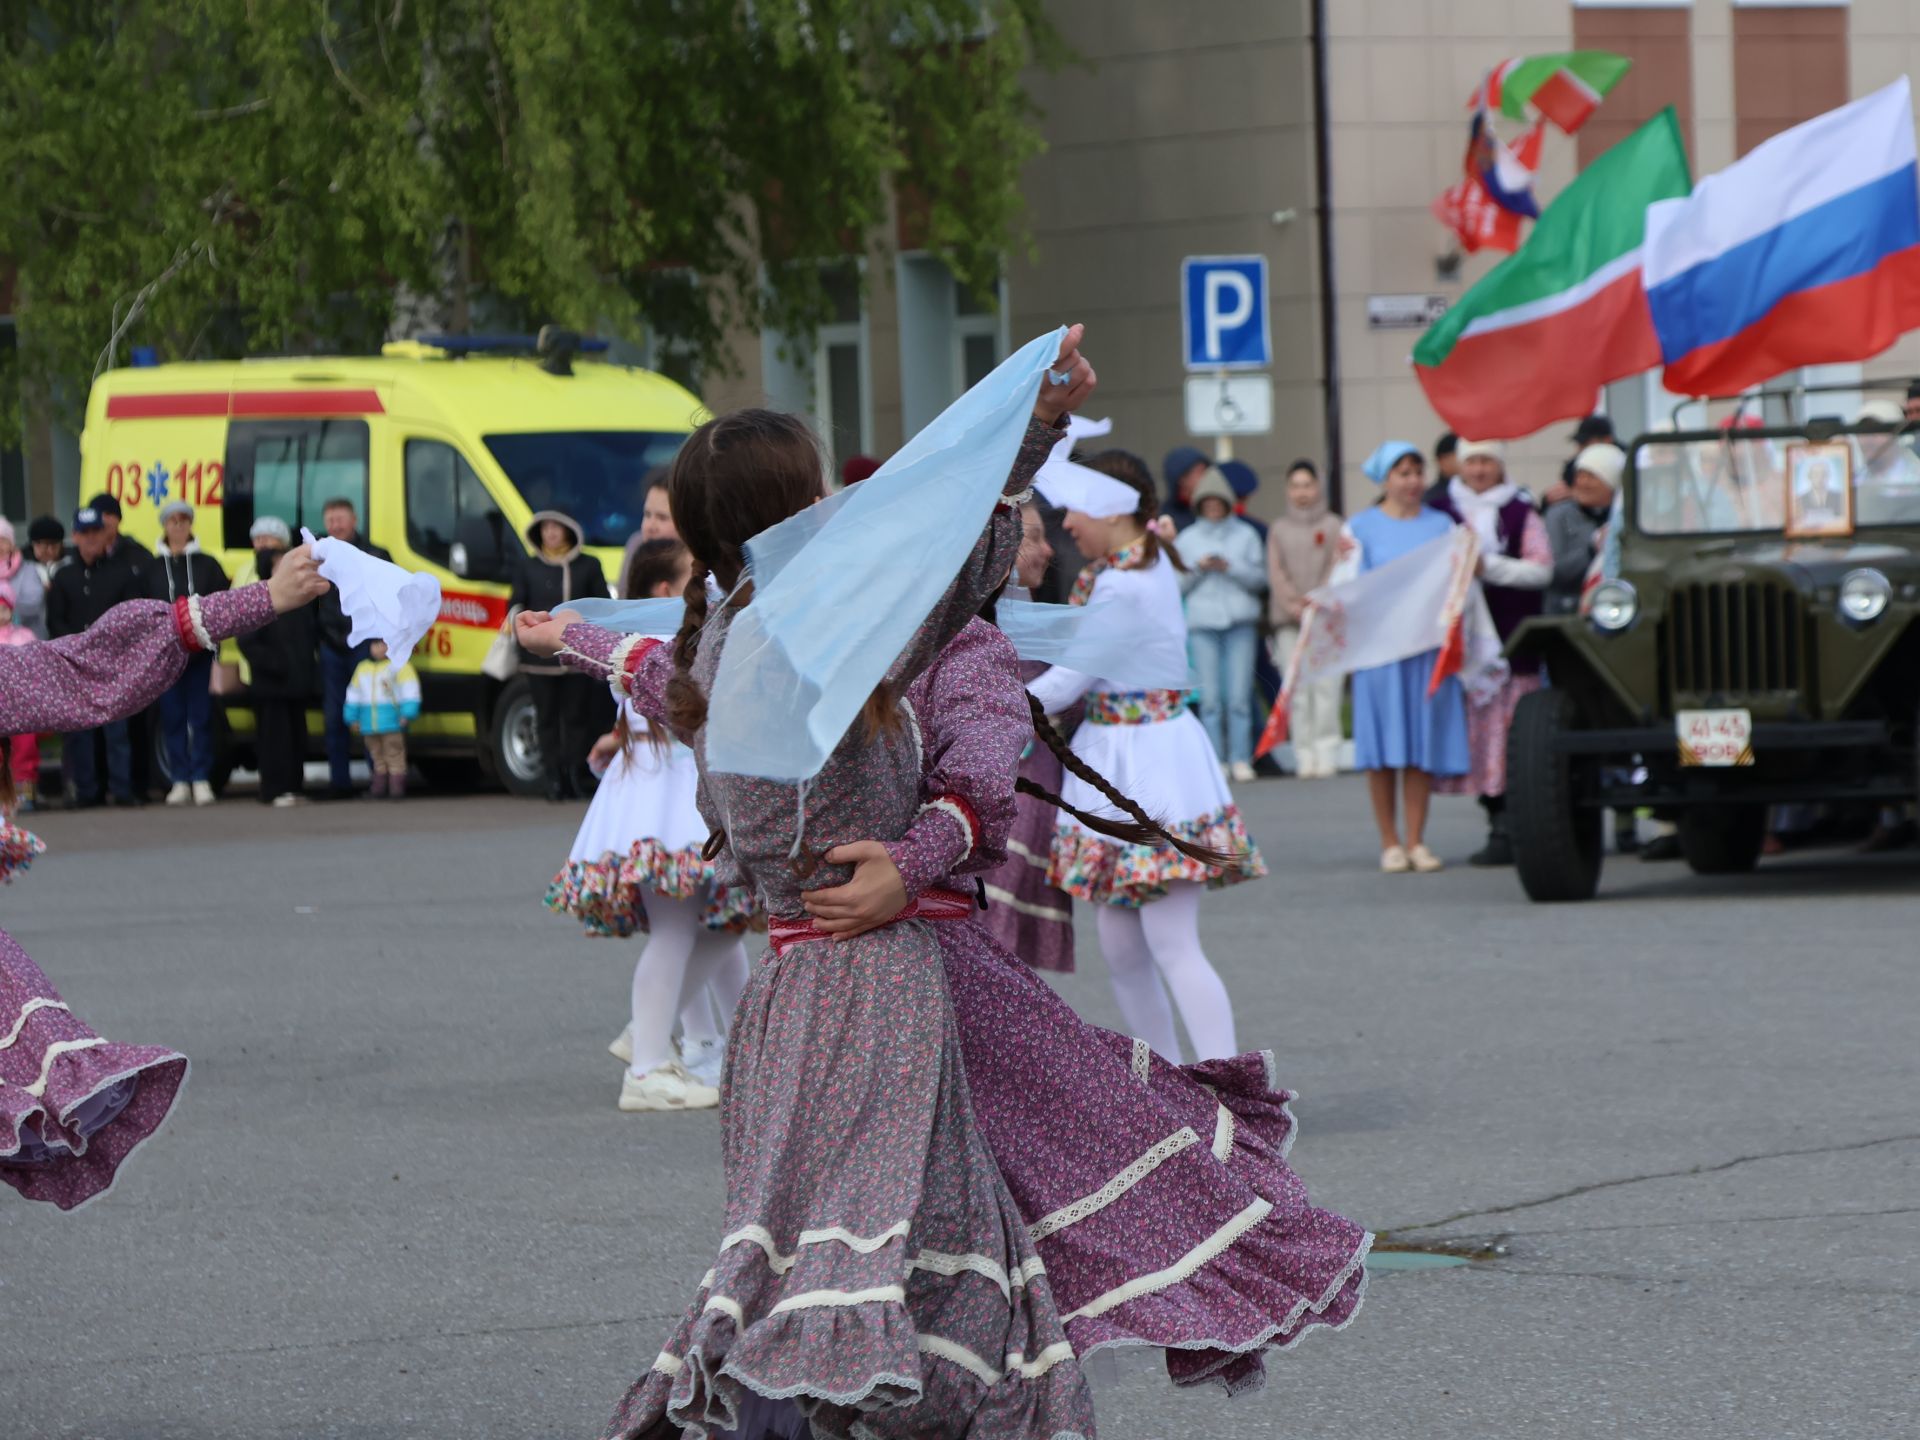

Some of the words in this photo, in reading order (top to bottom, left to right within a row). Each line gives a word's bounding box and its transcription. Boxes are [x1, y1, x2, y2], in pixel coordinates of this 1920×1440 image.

[1204, 269, 1254, 360] P
[107, 462, 142, 506] 03
[174, 461, 225, 506] 112
[411, 627, 452, 657] 76
